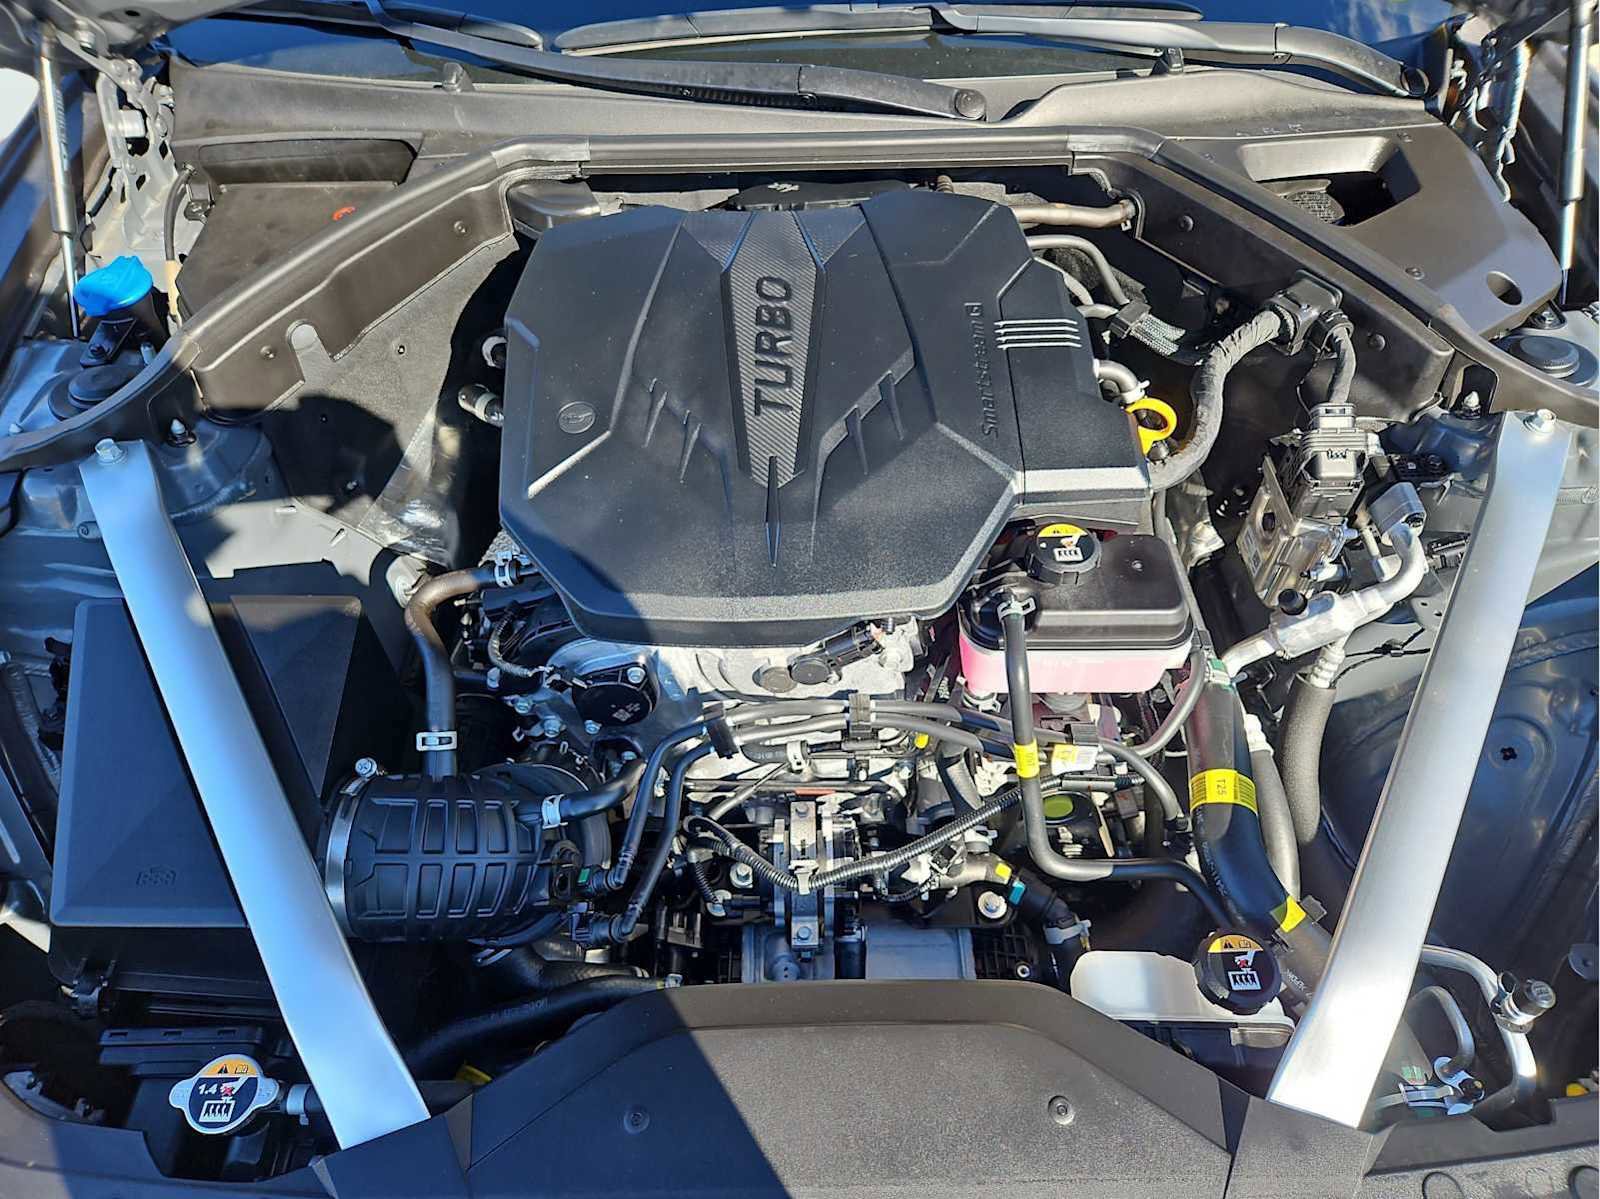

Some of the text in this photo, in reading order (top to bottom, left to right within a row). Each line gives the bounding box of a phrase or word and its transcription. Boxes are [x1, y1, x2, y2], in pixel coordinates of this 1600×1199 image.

[753, 275, 794, 416] TURBO
[971, 319, 999, 440] Smartstream
[198, 1083, 218, 1095] 1.4
